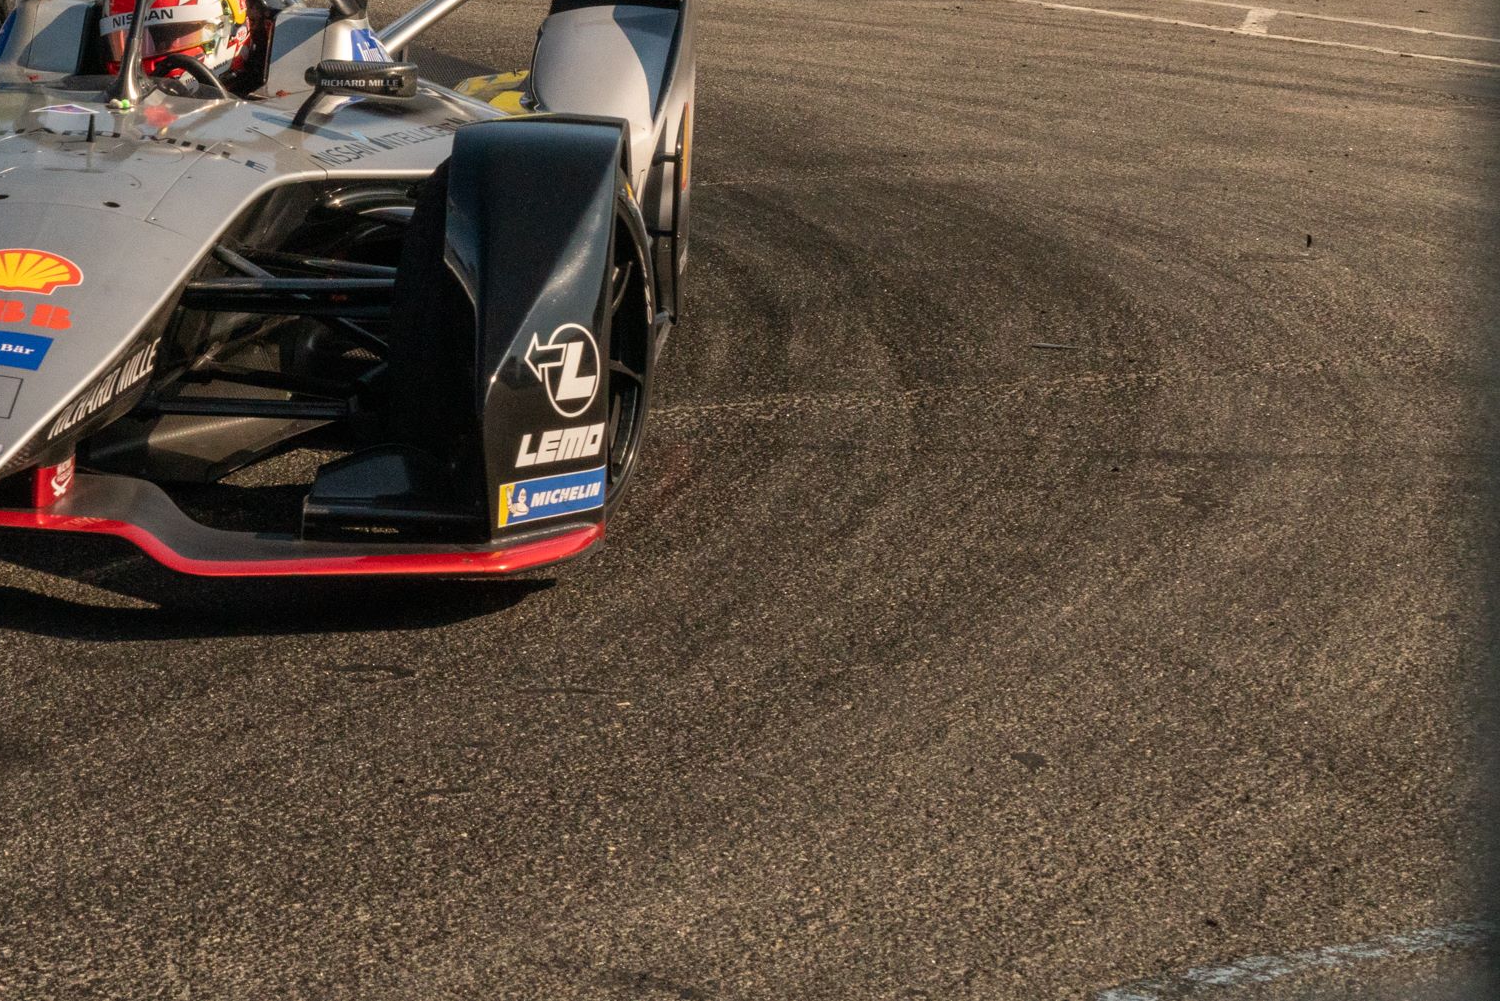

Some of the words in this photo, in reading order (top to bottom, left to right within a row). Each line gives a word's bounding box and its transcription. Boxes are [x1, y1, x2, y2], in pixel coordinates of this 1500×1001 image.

[112, 9, 174, 28] NISAN
[320, 79, 366, 87] RICHARD
[368, 79, 400, 88] MILLE
[0, 343, 35, 355] Bär
[47, 367, 122, 441] RICHARD
[115, 336, 162, 395] MILLE
[515, 422, 606, 468] LEMO
[529, 481, 602, 509] MICHELIN
